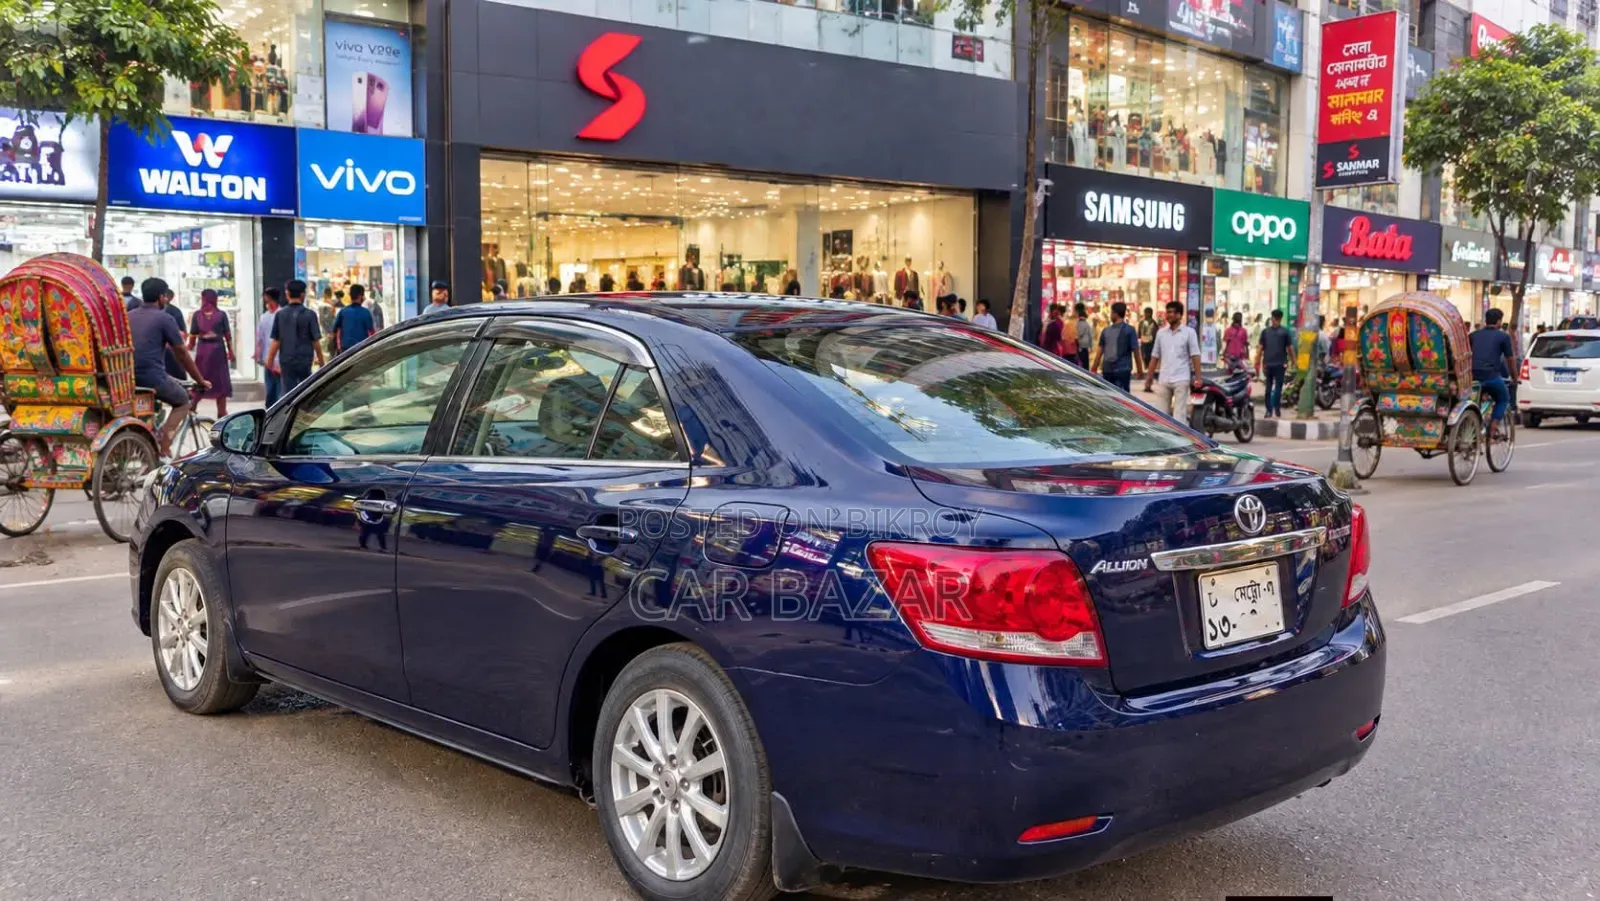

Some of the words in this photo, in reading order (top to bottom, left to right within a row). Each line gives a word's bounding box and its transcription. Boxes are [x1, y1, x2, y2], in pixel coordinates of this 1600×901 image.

[310, 158, 416, 195] vivo
[1336, 159, 1379, 172] SANMAR
[138, 167, 267, 201] WALTON
[1084, 190, 1185, 231] SAMSUNG
[1231, 210, 1297, 245] oppo
[1342, 215, 1413, 260] Bata
